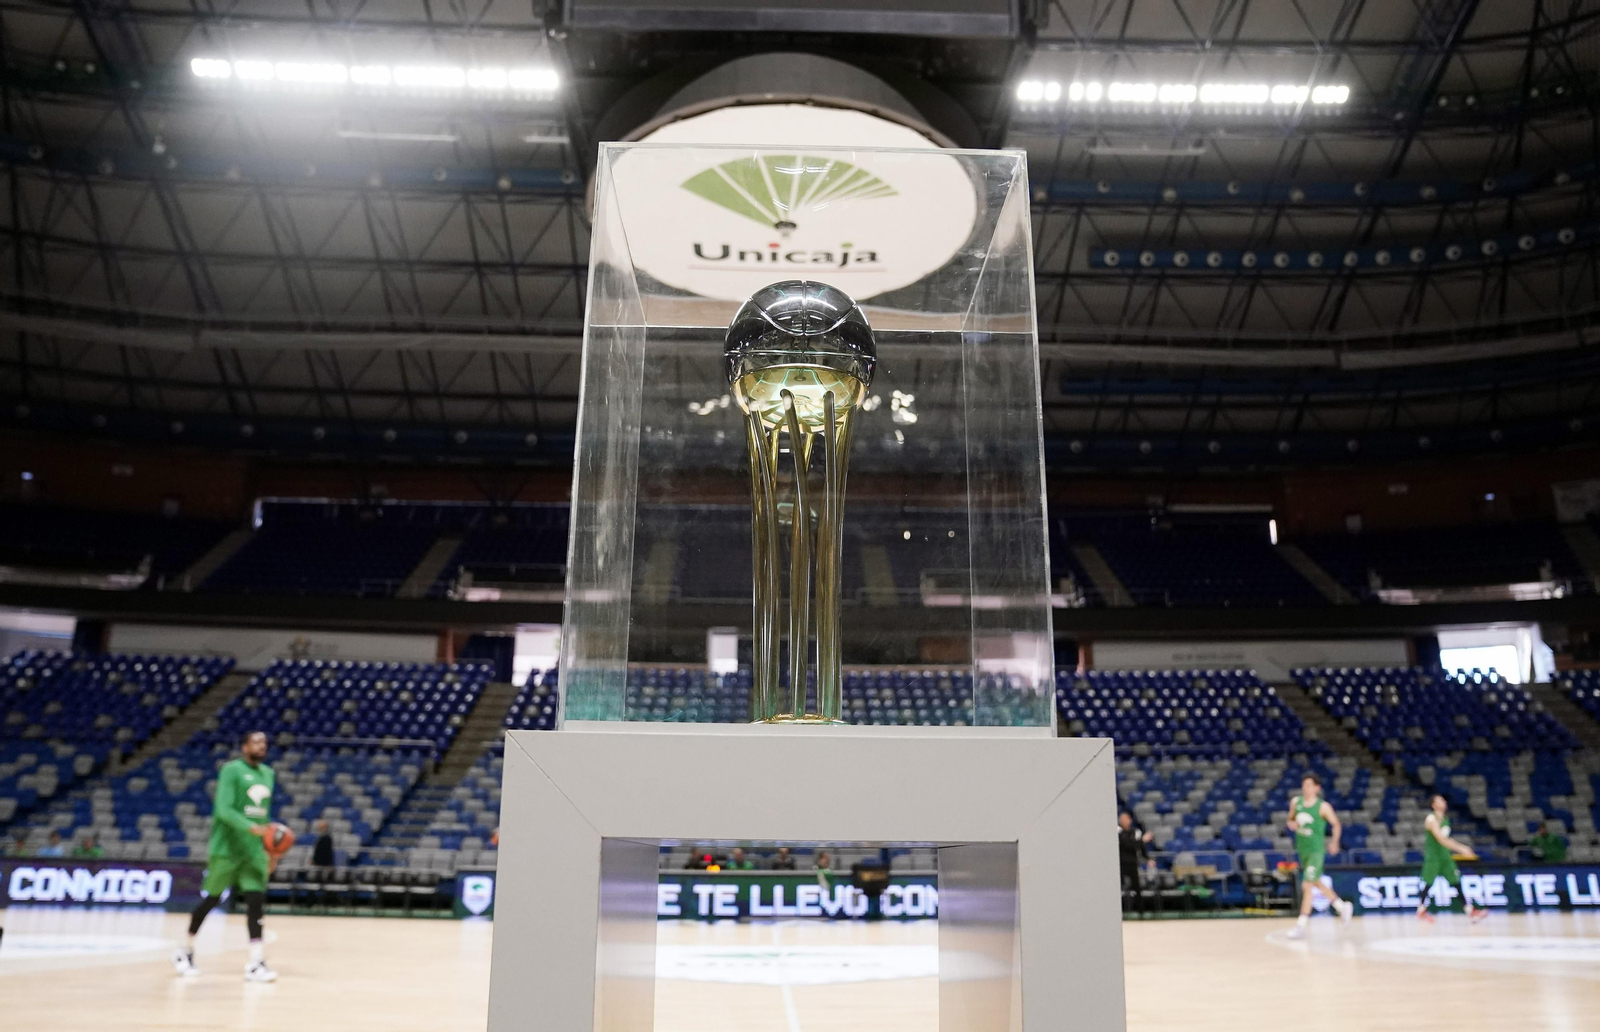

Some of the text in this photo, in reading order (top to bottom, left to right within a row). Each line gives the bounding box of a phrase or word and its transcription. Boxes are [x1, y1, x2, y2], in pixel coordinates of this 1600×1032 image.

[693, 242, 879, 267] Unicaja
[8, 866, 173, 903] CONMIGO
[692, 884, 739, 916] TE
[1515, 873, 1560, 906] TE
